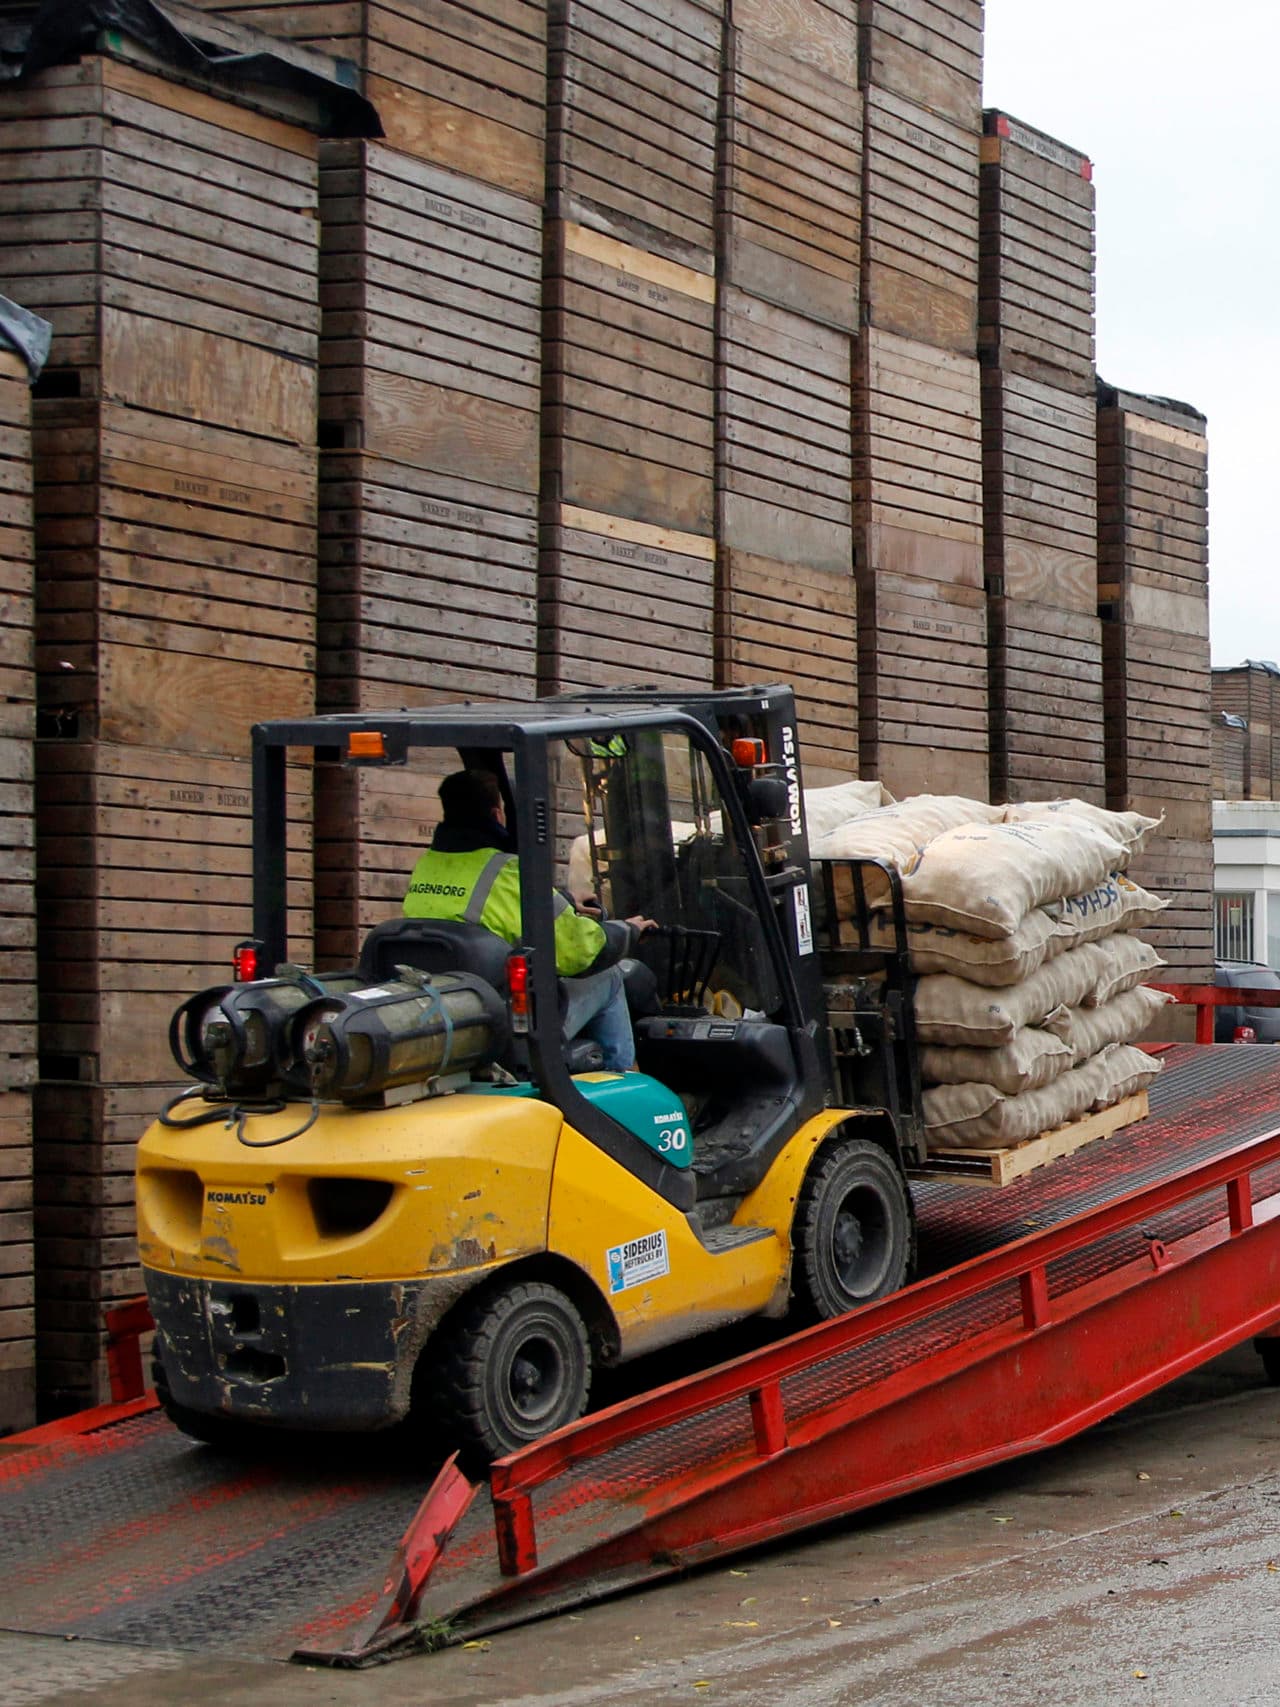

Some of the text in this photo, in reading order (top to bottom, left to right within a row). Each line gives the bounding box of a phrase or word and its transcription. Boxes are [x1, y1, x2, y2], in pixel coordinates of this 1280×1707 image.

[782, 726, 802, 836] KOMATSU
[408, 883, 467, 897] AGENBORG
[658, 1128, 686, 1152] 30
[207, 1191, 267, 1205] KOMATSU
[623, 1232, 662, 1261] SIDERIUS
